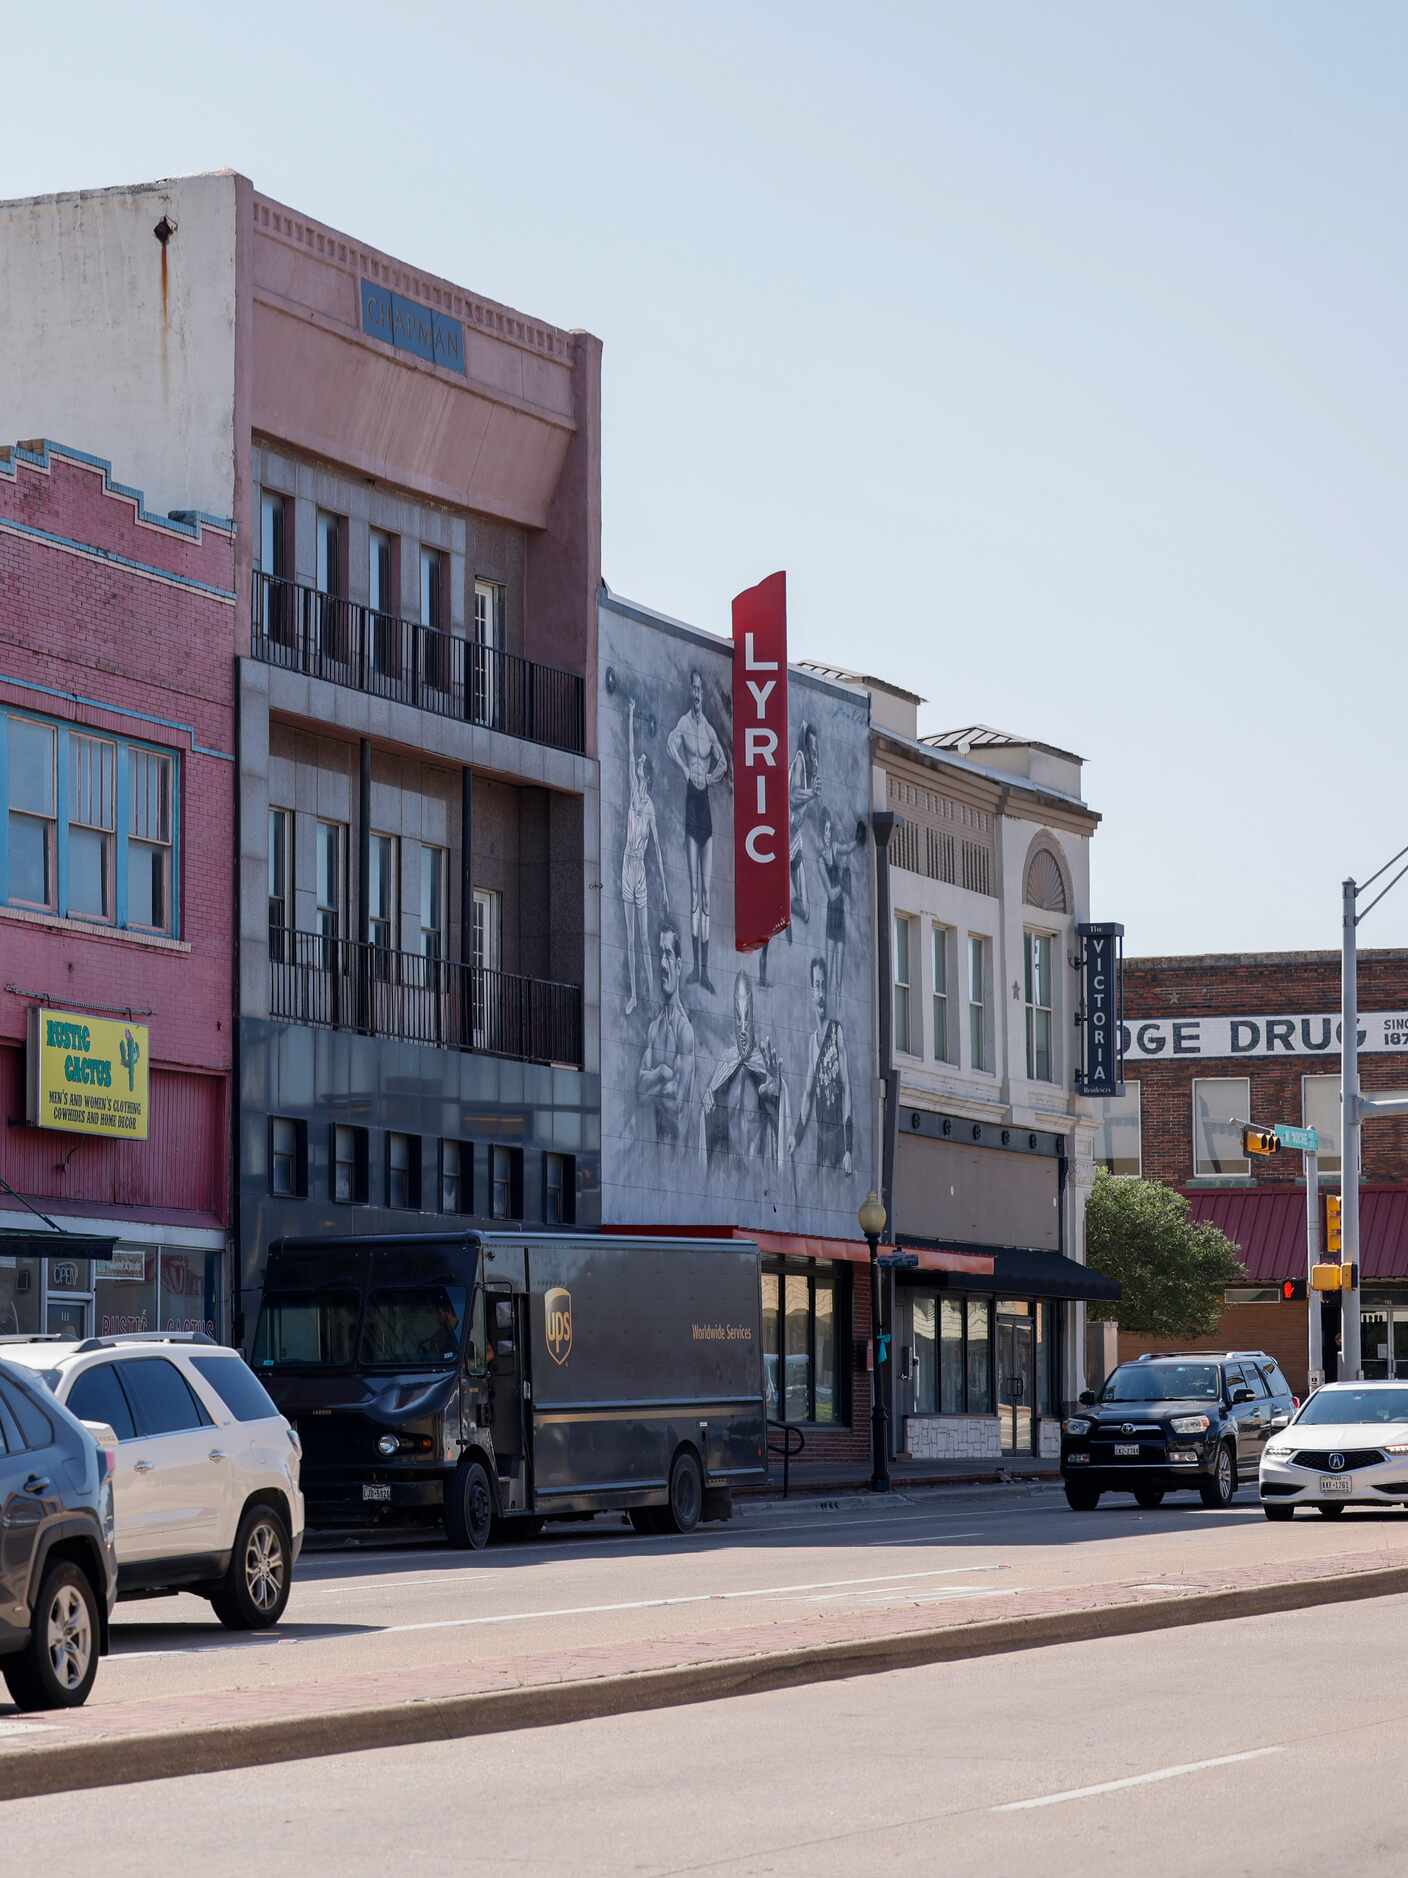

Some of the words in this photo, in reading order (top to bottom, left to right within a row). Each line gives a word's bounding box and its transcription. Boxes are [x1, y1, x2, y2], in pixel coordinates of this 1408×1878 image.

[744, 632, 779, 864] LYRIC
[1093, 940, 1106, 1080] VICTORIA
[46, 1020, 91, 1052] RUSTIC
[64, 1055, 112, 1088] CACTUS
[48, 1089, 68, 1105] MEN'S
[69, 1093, 83, 1107] AND
[84, 1095, 112, 1111] WOMEN'S
[112, 1099, 142, 1115] CLOTHING
[53, 1107, 86, 1122] COWHIDES
[86, 1111, 99, 1125] AND
[100, 1113, 118, 1128] HOME
[548, 1311, 571, 1354] ups
[691, 1323, 725, 1340] Worldwide
[726, 1323, 752, 1340] Services
